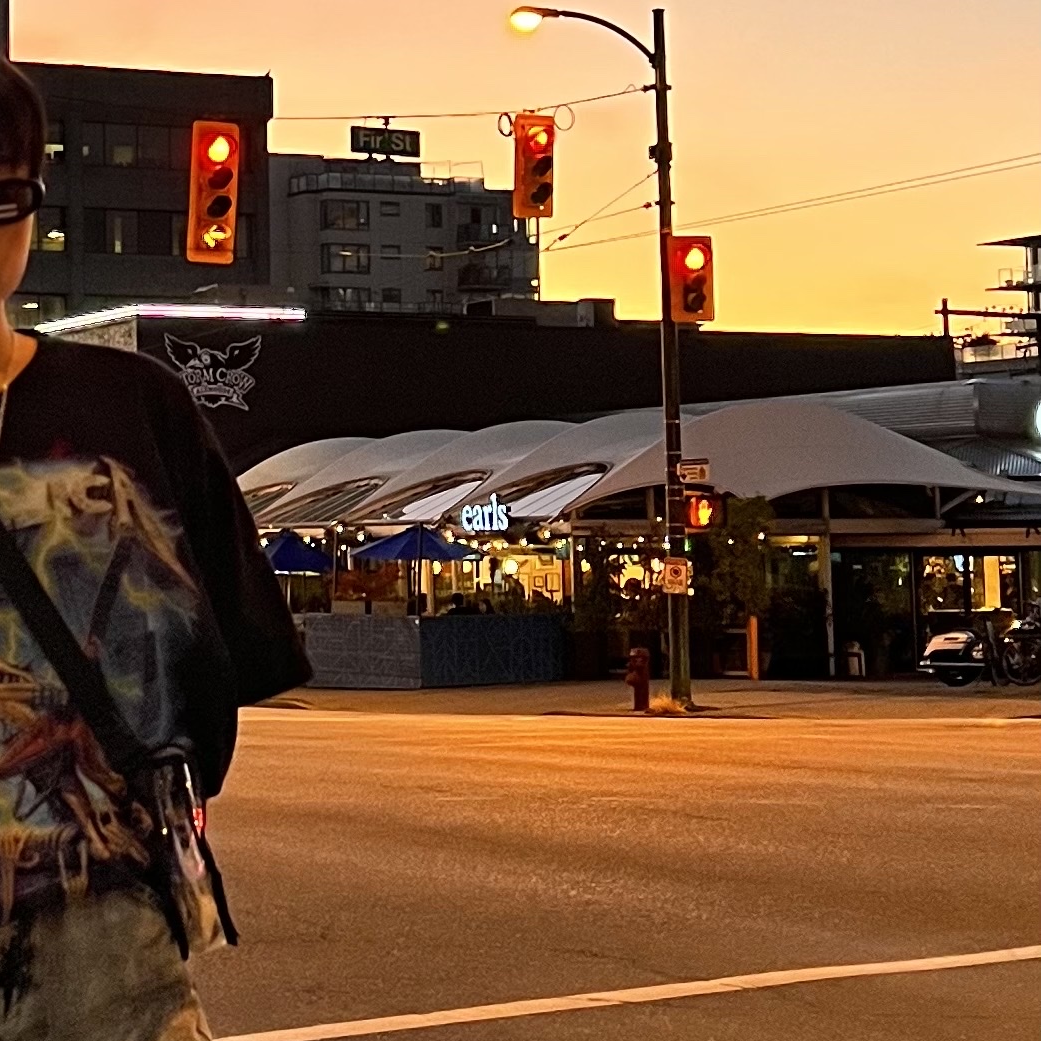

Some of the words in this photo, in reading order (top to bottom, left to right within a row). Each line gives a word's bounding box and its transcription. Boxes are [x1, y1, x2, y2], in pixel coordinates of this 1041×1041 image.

[360, 130, 383, 149] Fir
[391, 132, 412, 152] St
[182, 367, 214, 386] TORM
[461, 492, 509, 532] earls
